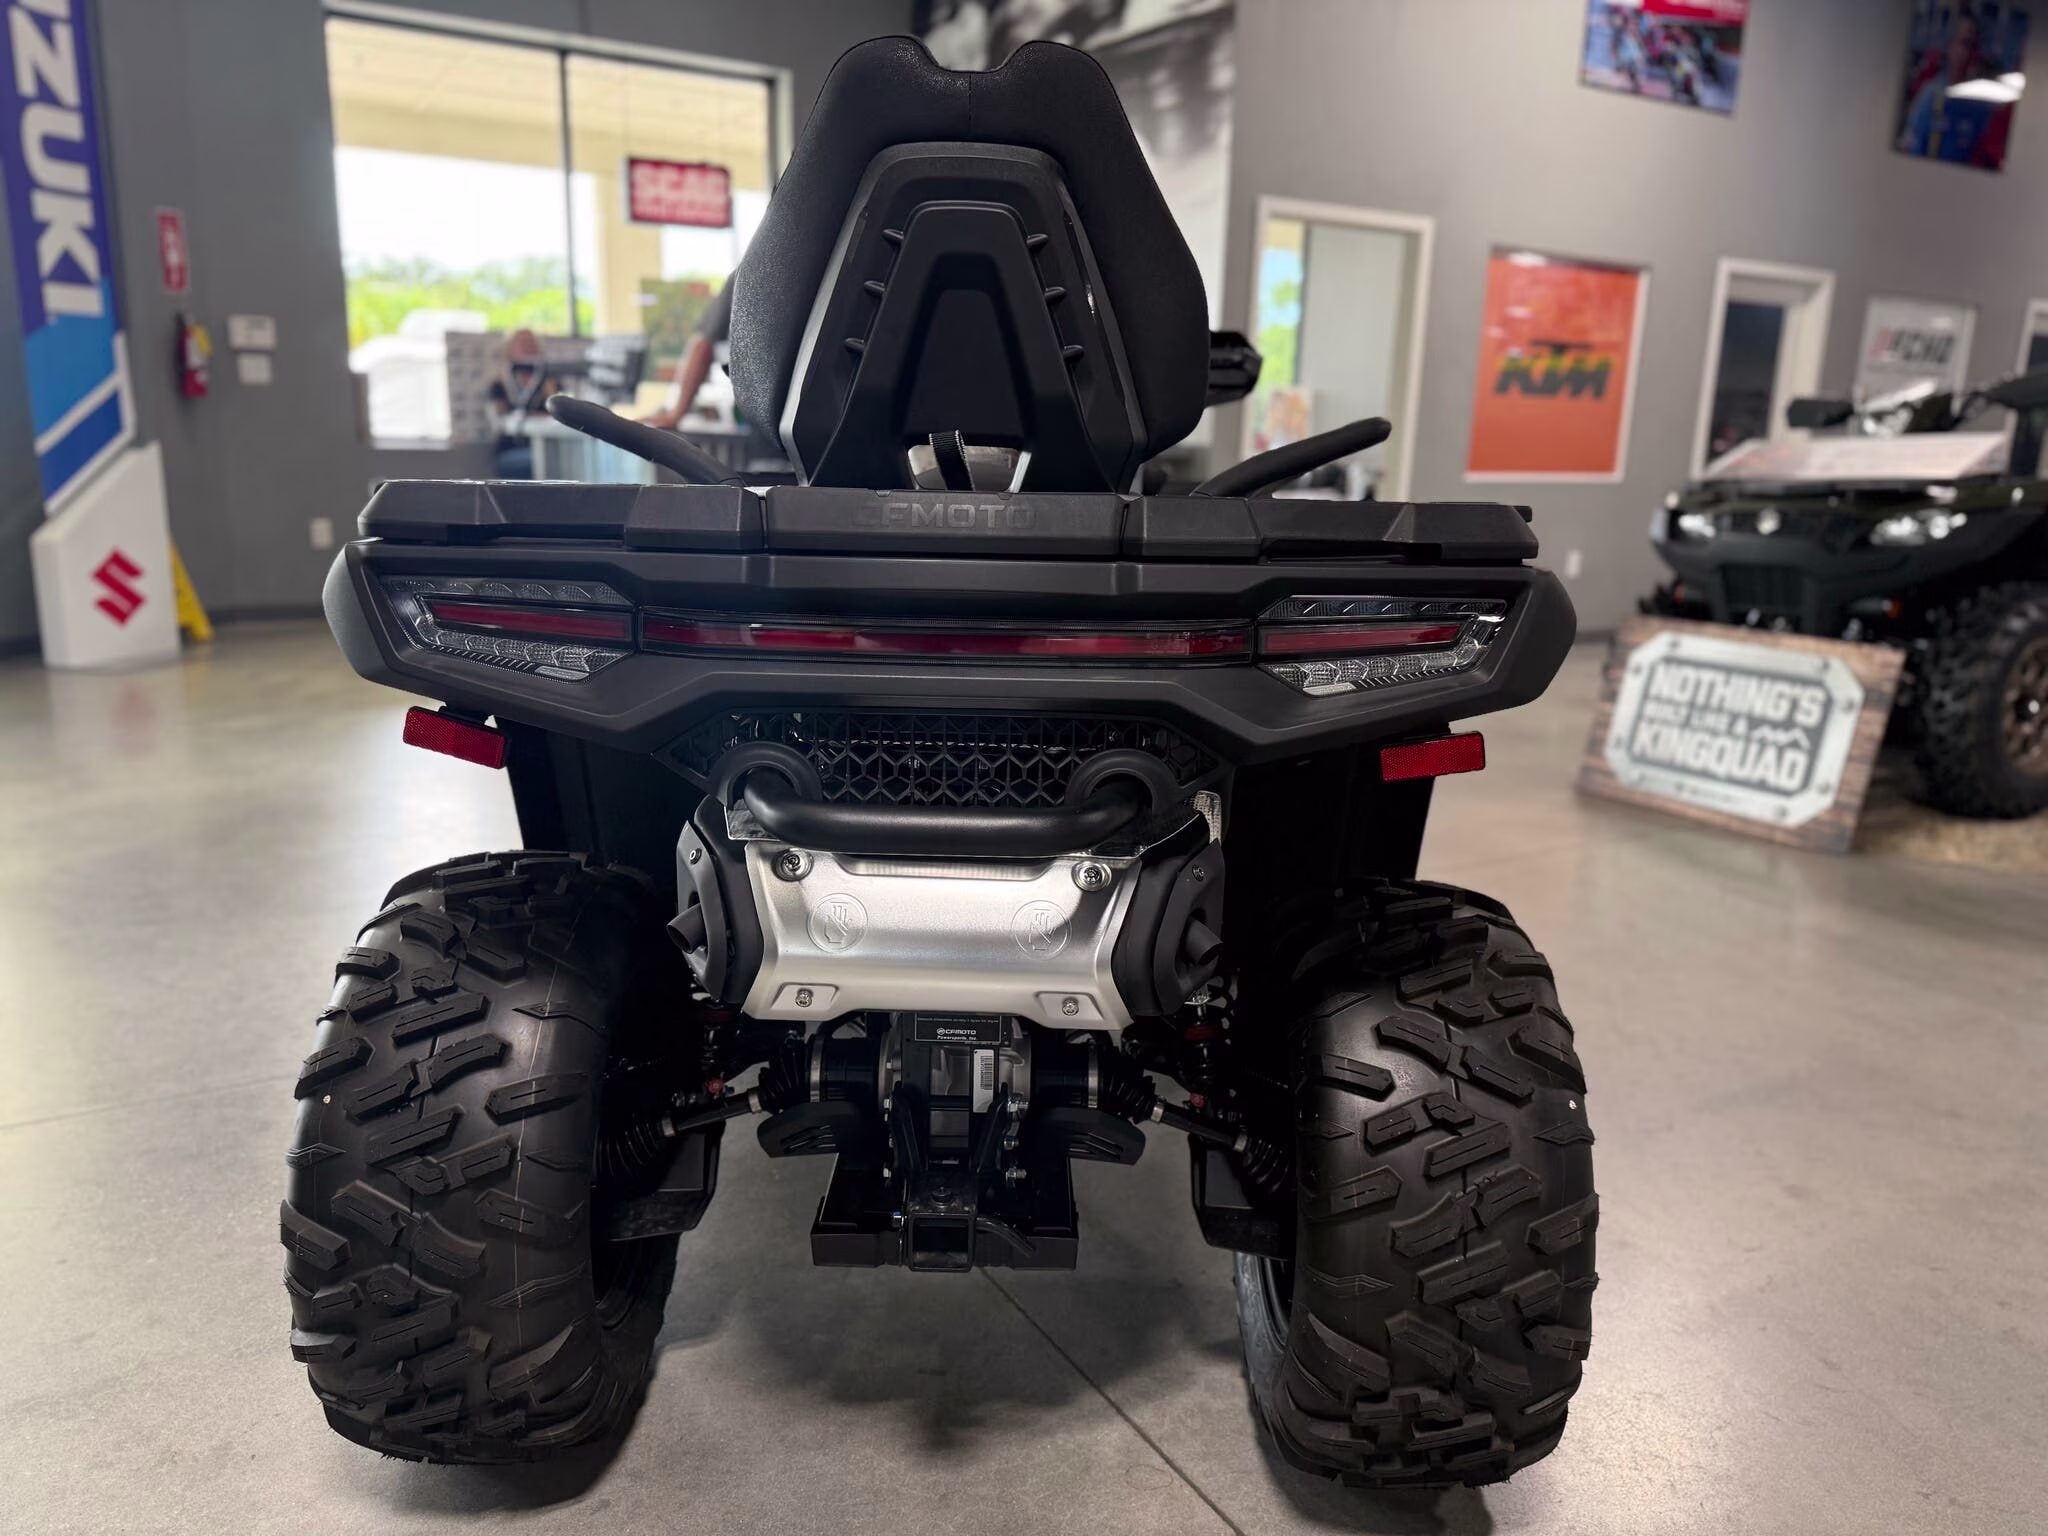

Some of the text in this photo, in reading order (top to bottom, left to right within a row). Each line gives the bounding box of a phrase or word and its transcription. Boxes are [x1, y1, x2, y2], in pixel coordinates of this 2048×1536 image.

[7, 0, 104, 318] ZUKI
[1494, 338, 1613, 402] KTM
[852, 502, 1036, 529] CFMOTO
[1651, 662, 1827, 728] NOTHING'S
[1732, 716, 1749, 736] A
[1633, 722, 1808, 791] KINGQUAD
